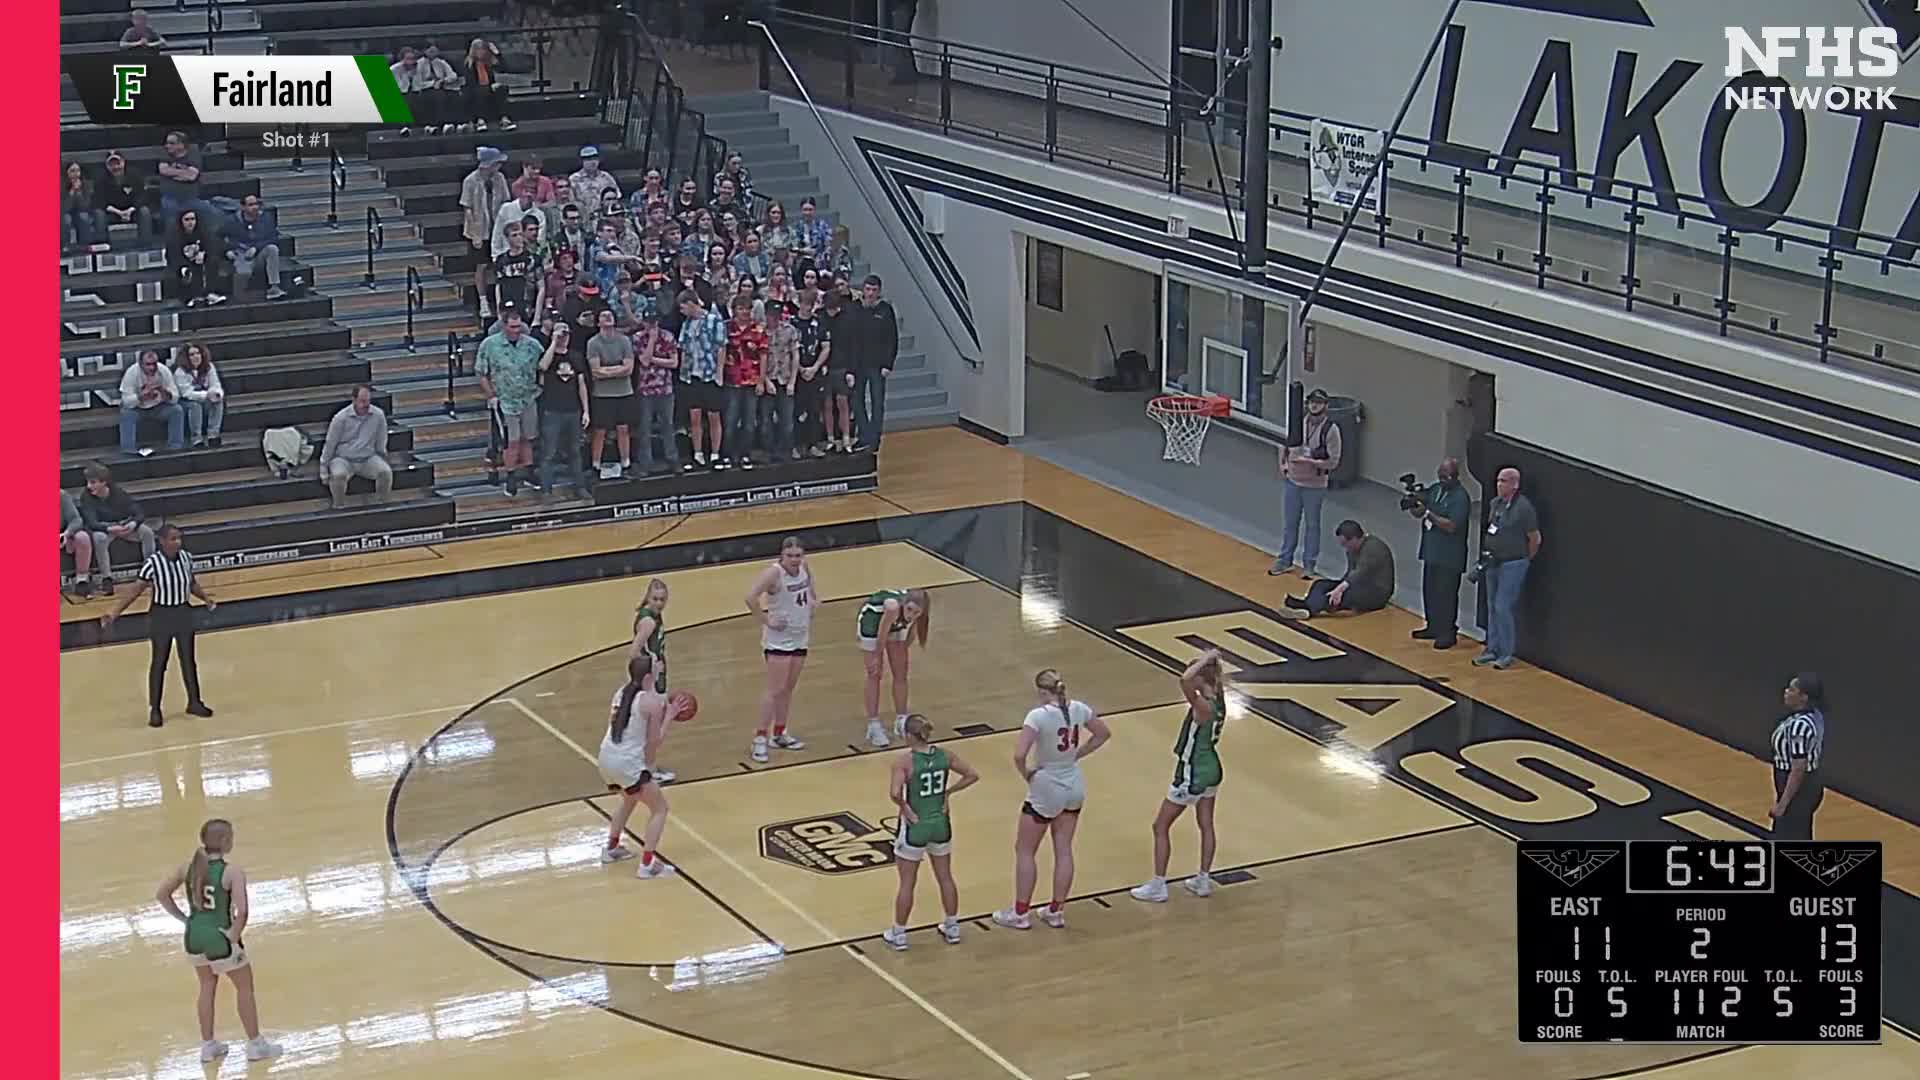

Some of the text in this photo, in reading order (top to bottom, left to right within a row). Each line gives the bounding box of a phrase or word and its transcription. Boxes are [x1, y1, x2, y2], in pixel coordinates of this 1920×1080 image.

[1336, 131, 1365, 149] WTGR
[1427, 23, 1920, 262] LAKOT
[796, 591, 808, 607] 44
[1056, 723, 1079, 752] 34
[919, 770, 945, 797] 33
[792, 820, 888, 867] GMC
